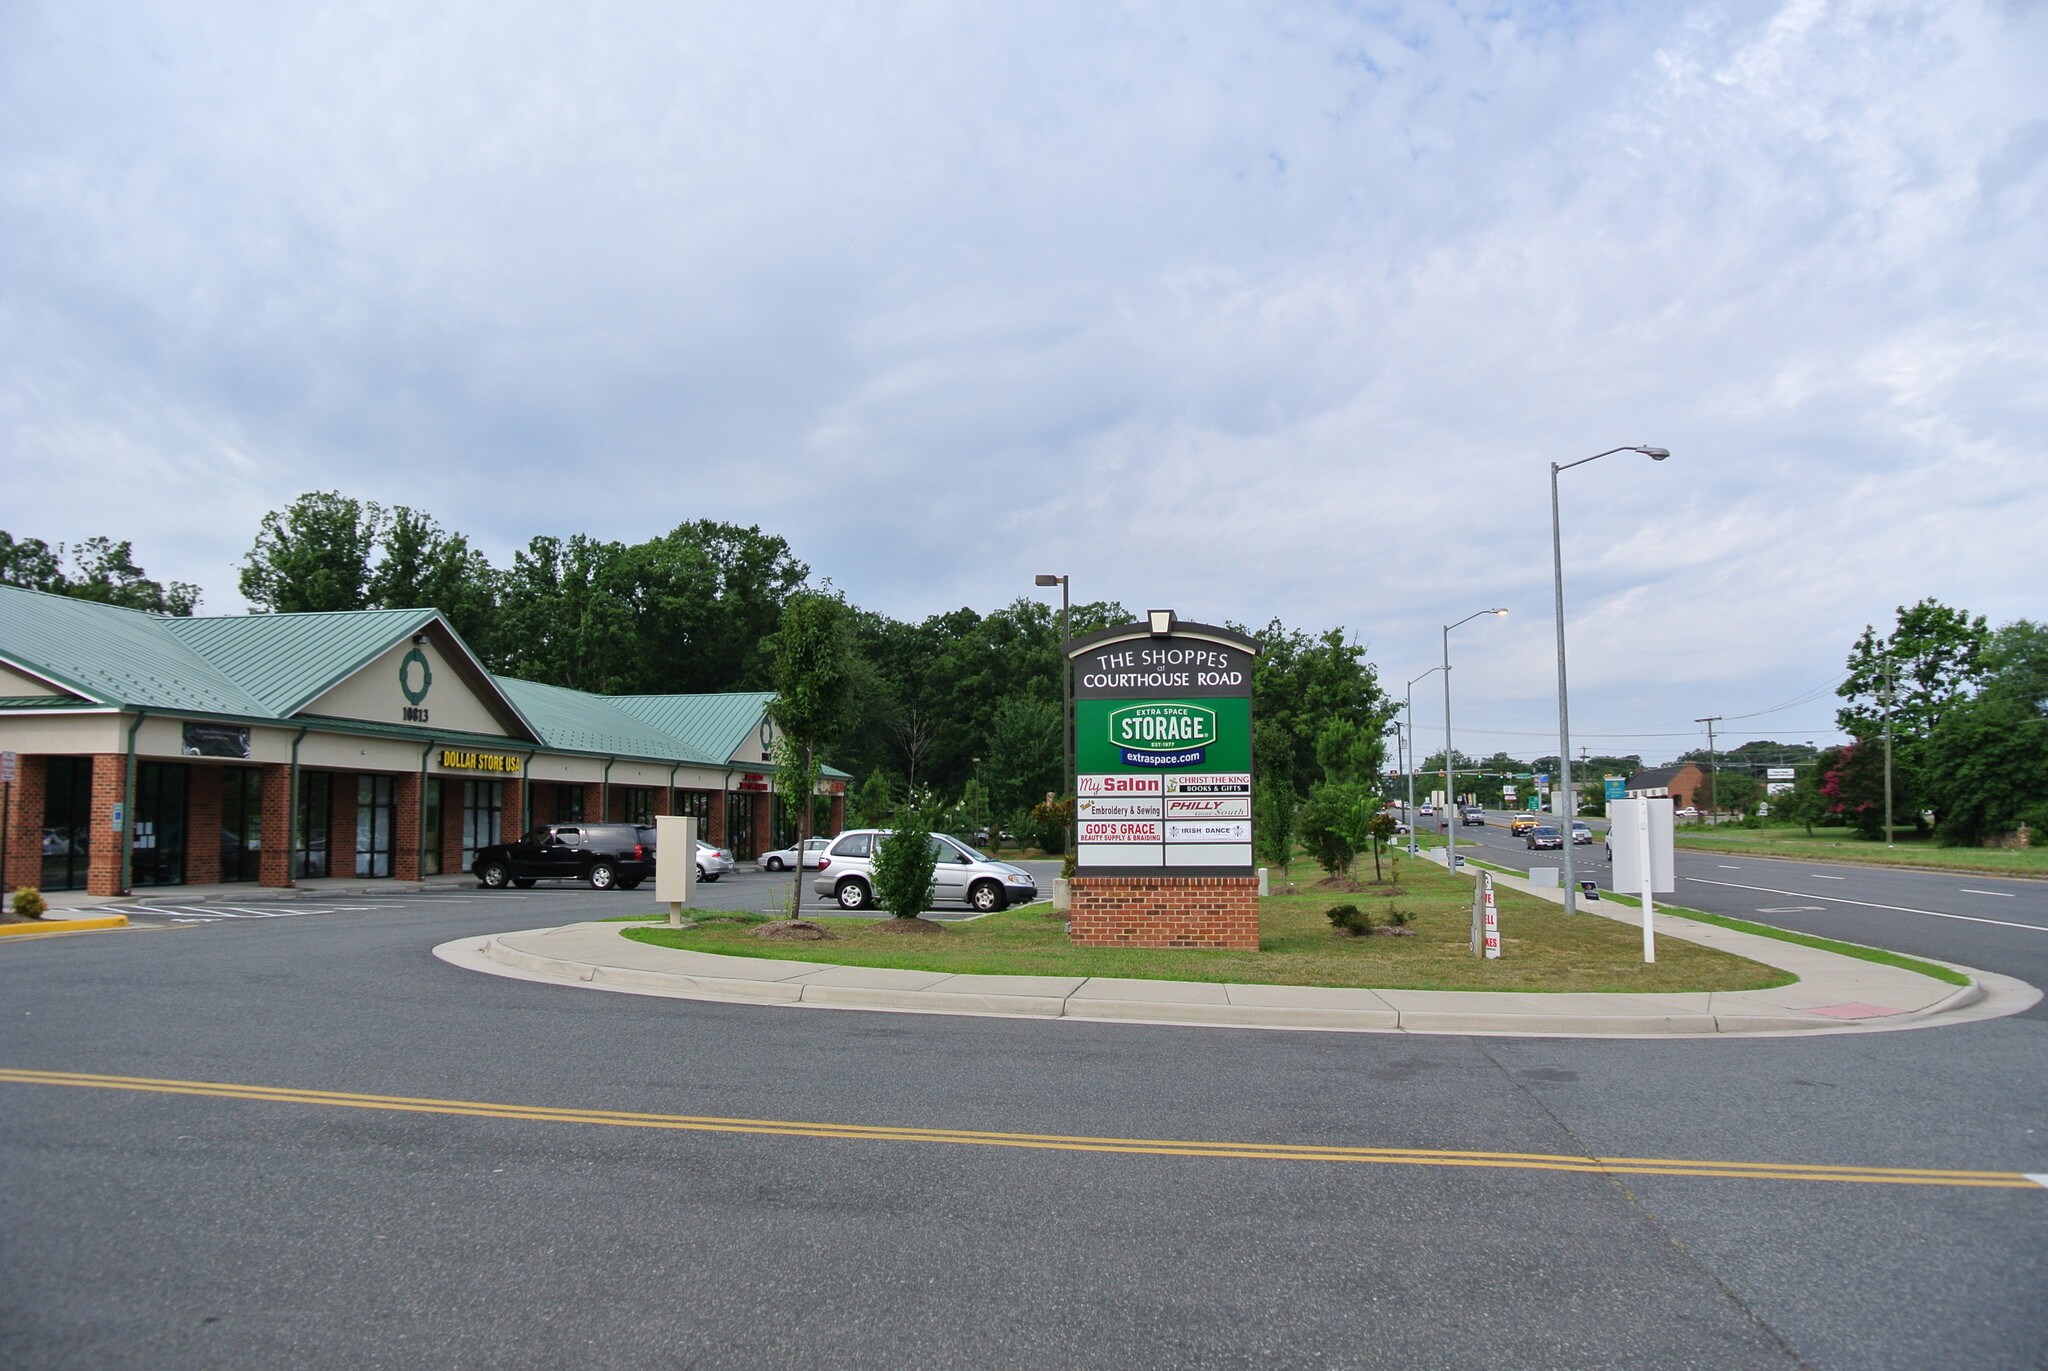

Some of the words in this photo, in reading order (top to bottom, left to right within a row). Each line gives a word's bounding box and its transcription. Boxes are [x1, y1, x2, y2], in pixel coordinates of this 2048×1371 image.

[1097, 651, 1135, 671] THE
[1142, 649, 1228, 669] SHOPPES
[1083, 672, 1190, 688] COURTHOUSE
[1197, 671, 1242, 686] ROAD
[402, 706, 429, 723] 10813
[1136, 708, 1161, 716] EXTRA
[1164, 708, 1188, 716] SPACE
[1121, 716, 1204, 741] STORAGE
[443, 750, 477, 769] DOLLAR
[478, 753, 504, 771] STORE
[505, 756, 520, 772] USA
[1127, 751, 1200, 765] extraspace.com
[1079, 777, 1102, 795] My
[1104, 777, 1159, 791] Salon
[1179, 776, 1208, 784] CHRIST
[1210, 776, 1227, 784] THE
[1228, 775, 1250, 783] KING
[1091, 805, 1128, 817] Embroidery
[1130, 806, 1135, 815] &
[1137, 805, 1160, 817] Sewing
[1169, 801, 1224, 810] PHILLY
[1214, 808, 1244, 816] South
[1086, 823, 1117, 835] GOD'S
[1120, 823, 1155, 835] GRACE
